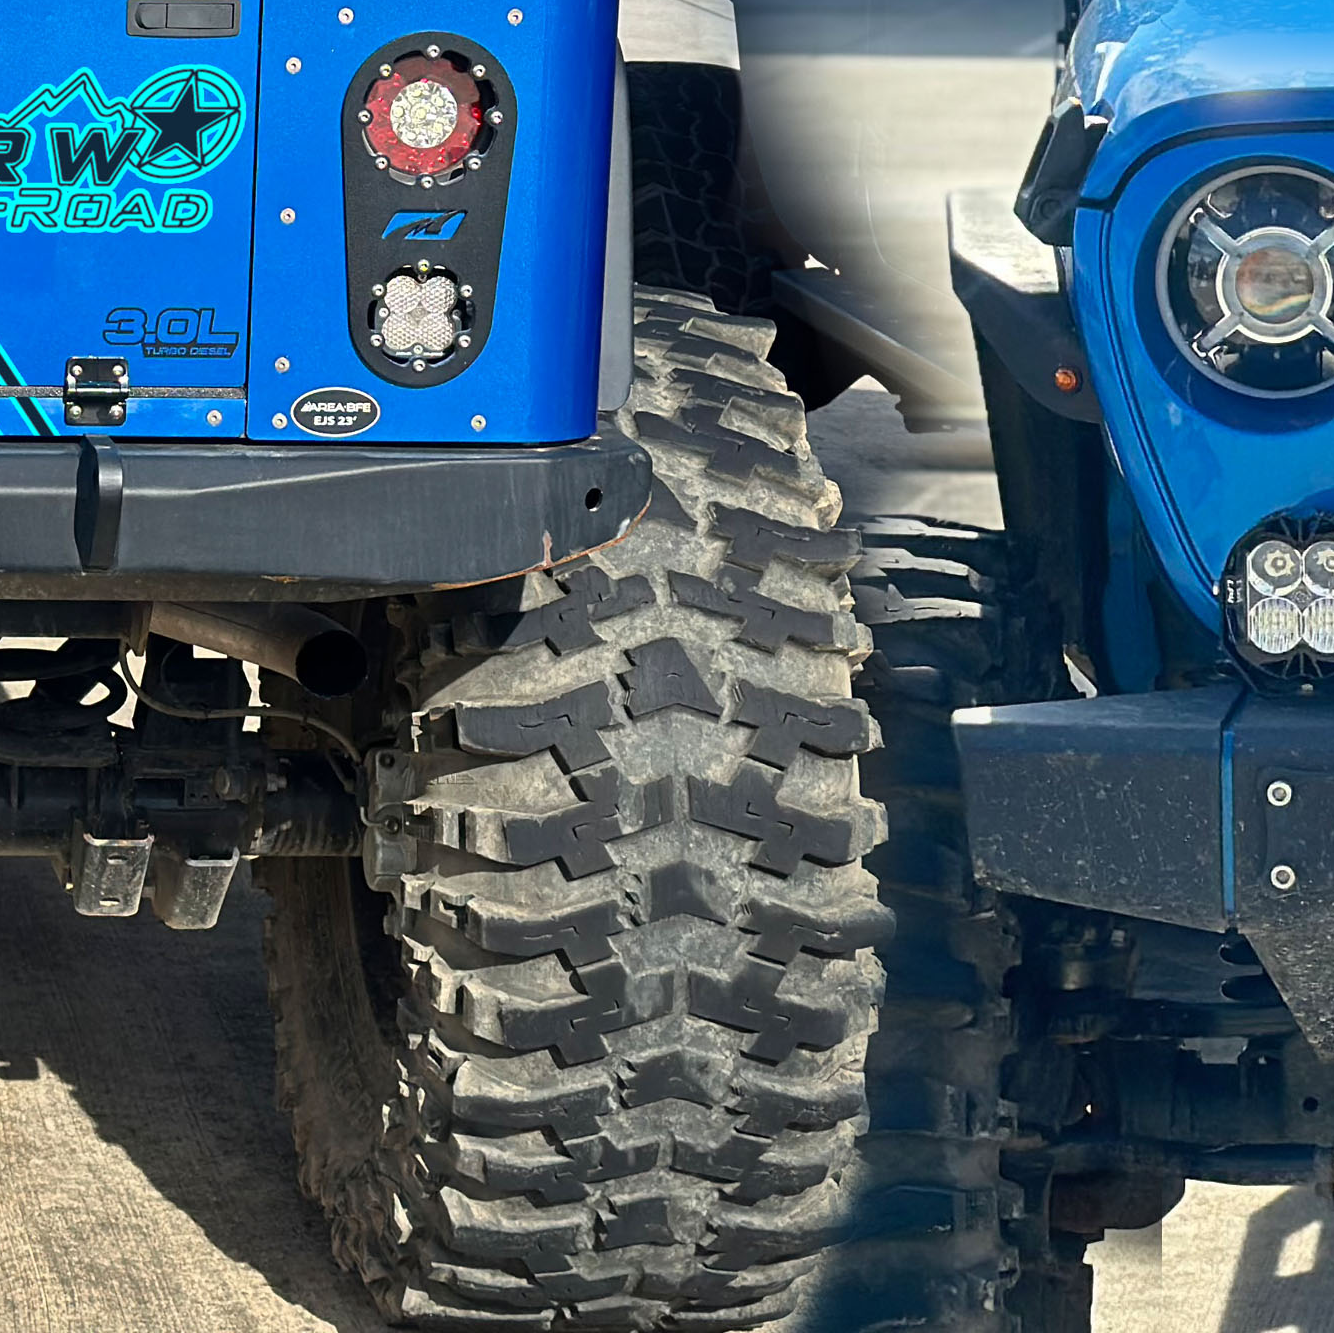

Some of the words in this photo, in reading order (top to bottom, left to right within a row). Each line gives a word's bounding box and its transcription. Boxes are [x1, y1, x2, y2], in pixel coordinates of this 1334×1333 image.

[103, 308, 239, 345] 3.0L
[144, 346, 187, 356] TURBO
[189, 346, 232, 356] DIESEL
[313, 415, 336, 426] EJS
